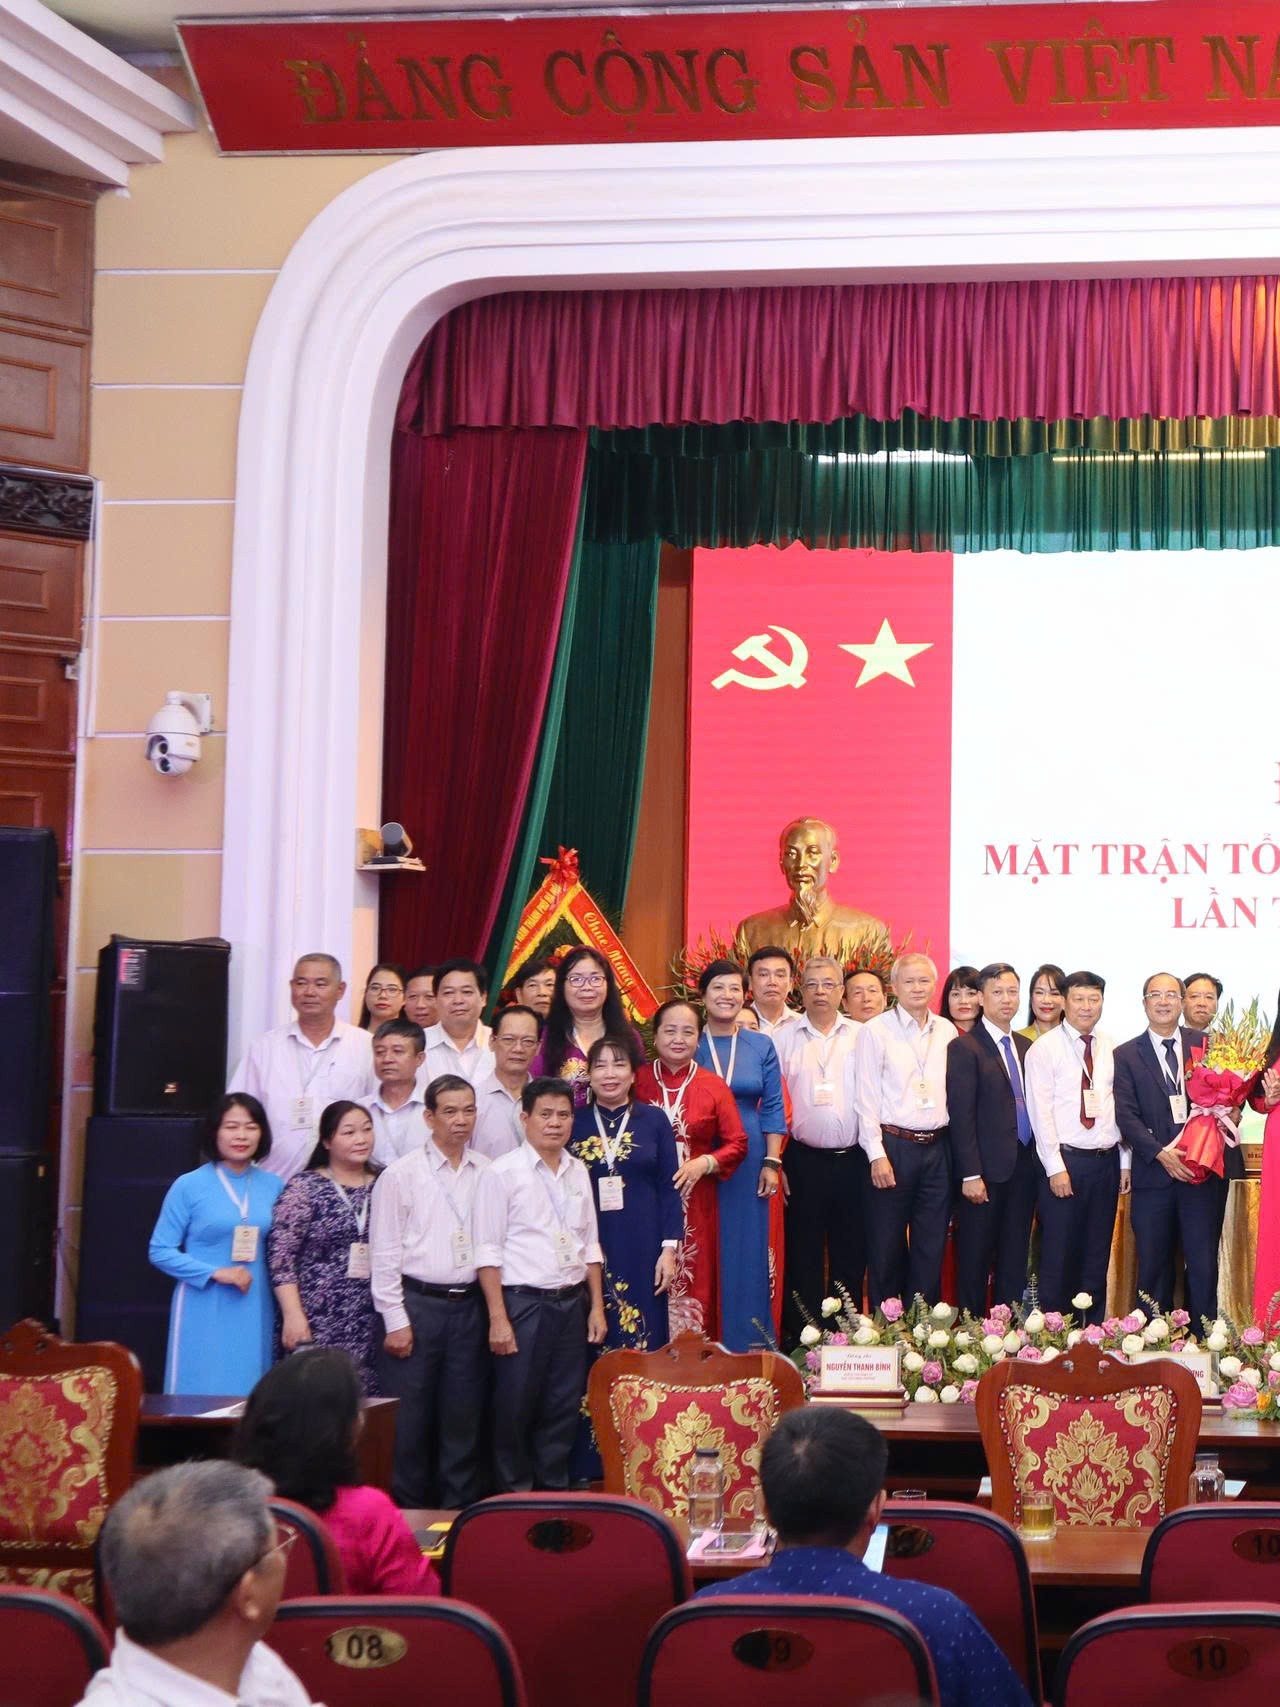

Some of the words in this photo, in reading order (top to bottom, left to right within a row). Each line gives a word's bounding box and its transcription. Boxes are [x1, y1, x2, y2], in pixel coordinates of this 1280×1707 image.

[286, 31, 513, 124] ĐẢNG
[544, 28, 760, 133] CỘNG
[789, 15, 952, 112] SẢN
[985, 17, 1176, 118] VIỆT
[983, 838, 1079, 884] MẶT
[1091, 838, 1210, 884] TRẬN
[1171, 886, 1258, 930] LẦN
[826, 1361, 852, 1371] NGUYỄN
[853, 1362, 874, 1371] THANH
[347, 1634, 384, 1661] 08
[1189, 1643, 1228, 1672] 10
